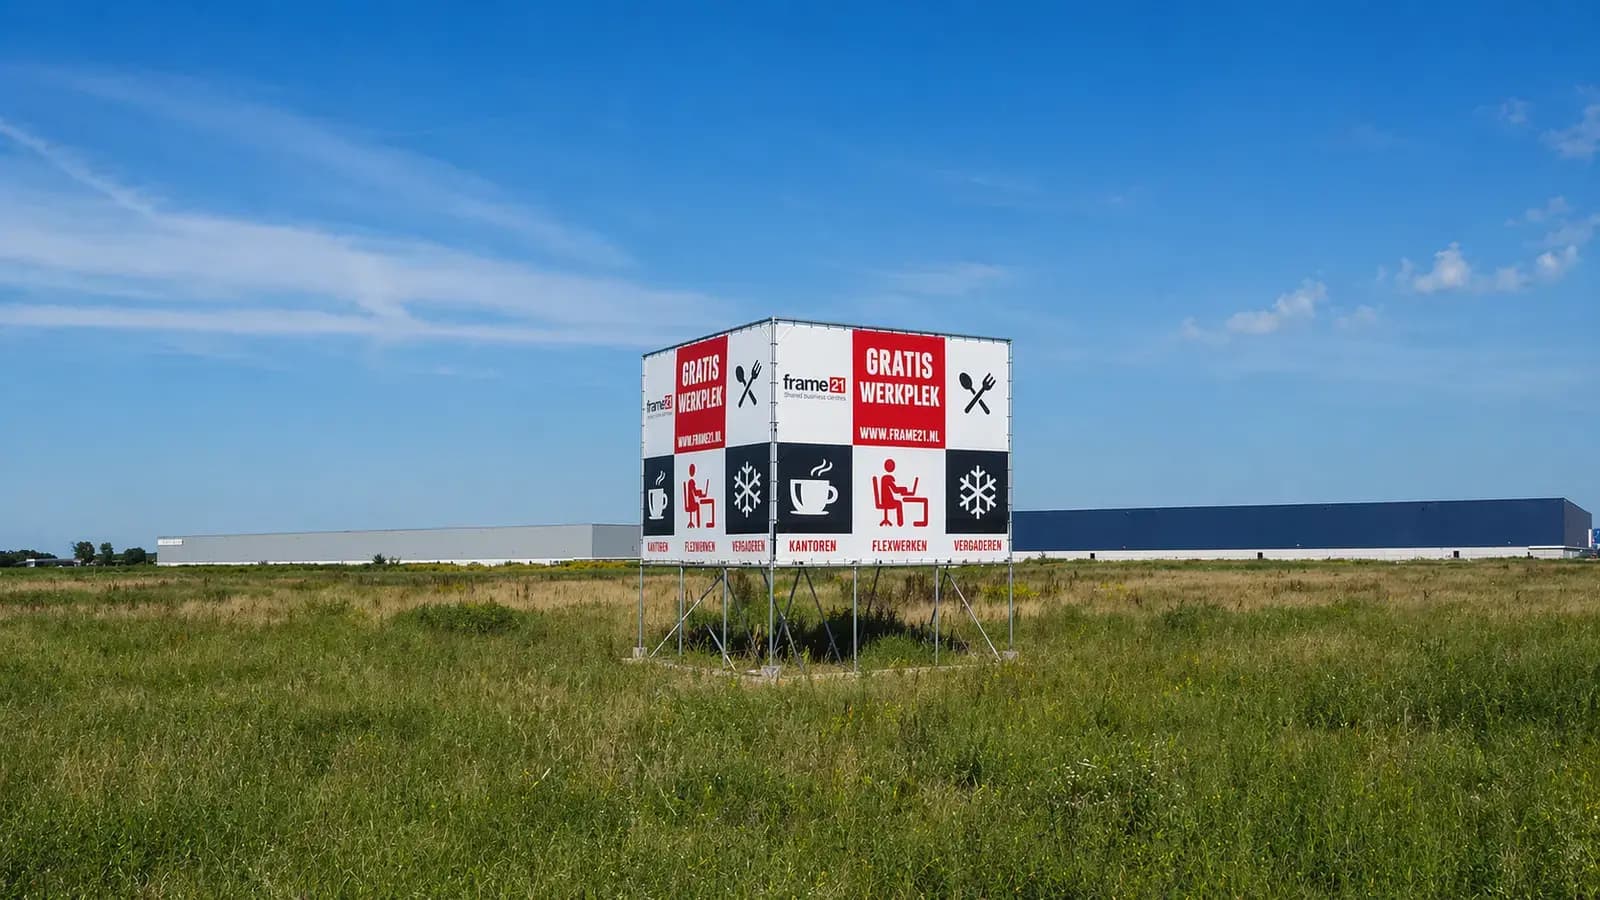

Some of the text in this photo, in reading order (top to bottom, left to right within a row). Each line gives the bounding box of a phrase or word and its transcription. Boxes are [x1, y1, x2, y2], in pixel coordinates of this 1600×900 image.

[682, 354, 720, 387] GRATIS
[866, 347, 933, 379] GRATIS
[678, 385, 723, 414] WERKPLEK
[859, 380, 940, 408] WERKPLEK
[859, 426, 940, 443] WWW.FRAME21.NL
[789, 540, 837, 552] KANTOREN
[872, 540, 927, 552] FLEXWERKEN
[954, 539, 1002, 551] VERGADEREN
